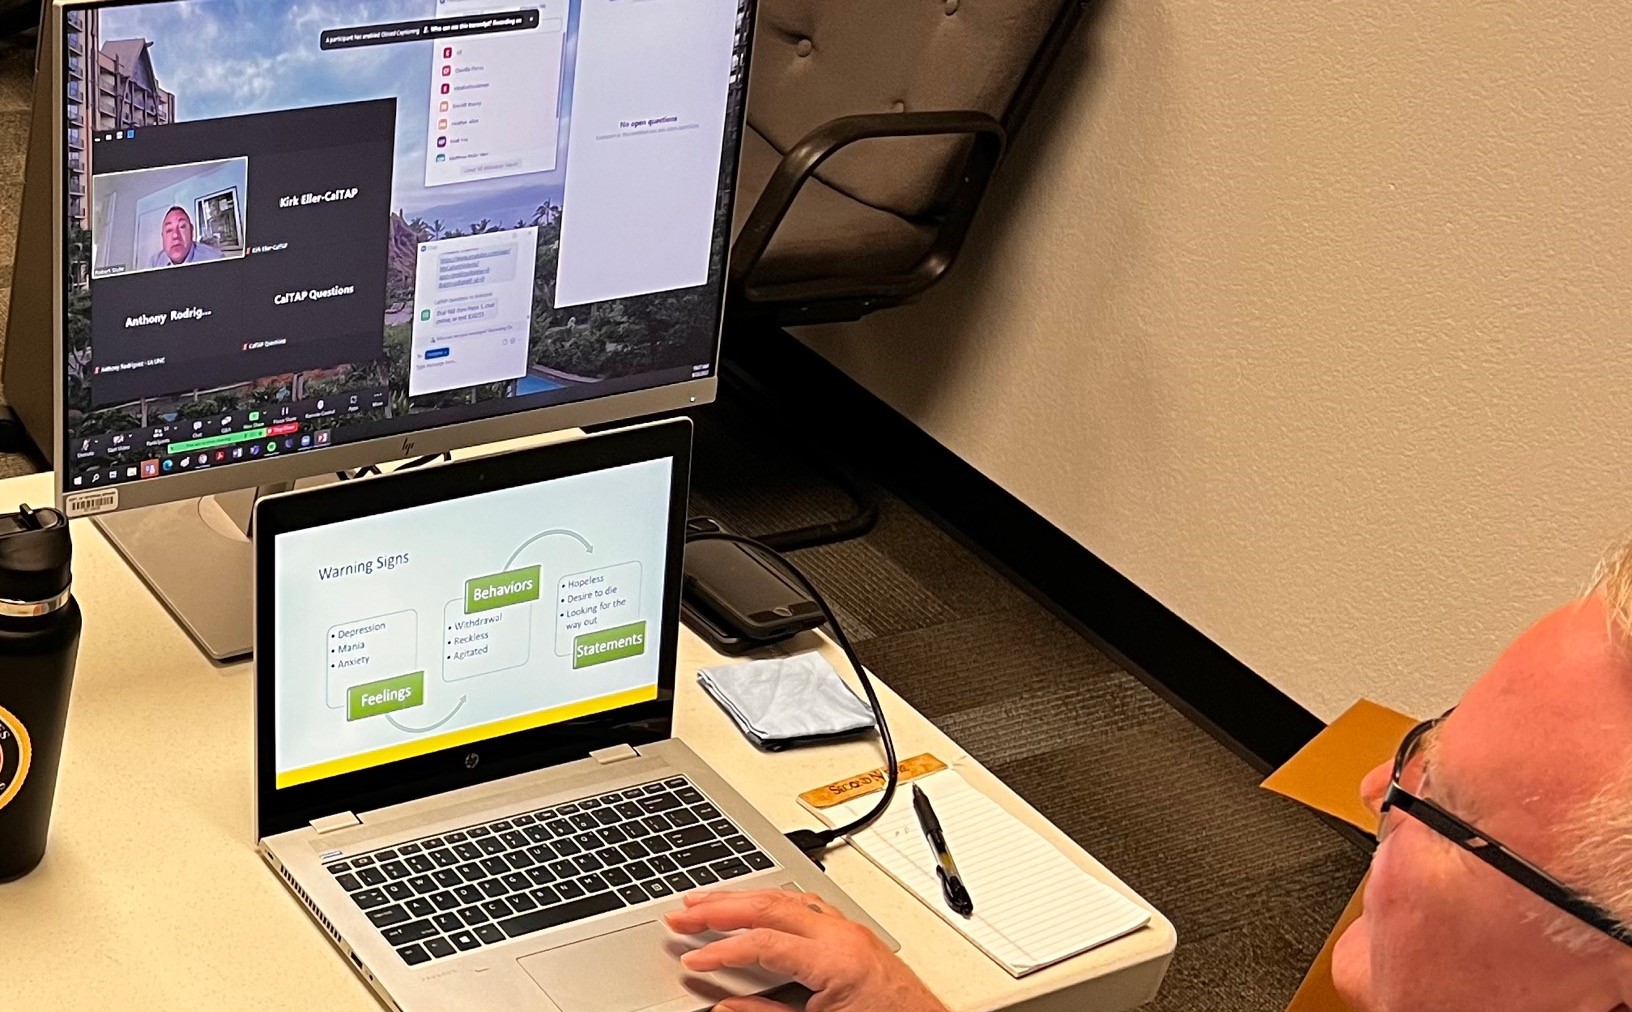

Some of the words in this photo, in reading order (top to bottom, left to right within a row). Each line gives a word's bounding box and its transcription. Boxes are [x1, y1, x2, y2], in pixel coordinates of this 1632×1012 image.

[630, 120, 647, 128] open
[648, 116, 678, 127] questions
[279, 197, 299, 208] Kirk
[301, 188, 359, 206] Eller-CalTAP
[274, 291, 307, 305] CalTAP
[308, 285, 354, 301] Questions
[125, 313, 167, 328] Anthony
[170, 307, 212, 321] Rodrig...
[319, 560, 373, 581] Warning
[376, 552, 409, 570] Signs
[473, 579, 533, 602] Behaviors
[568, 575, 604, 589] Hopeless
[567, 592, 593, 604] Desire
[604, 586, 618, 595] die
[567, 605, 598, 618] Looking
[599, 601, 611, 610] for
[612, 598, 627, 608] the
[454, 612, 503, 631] Withdrawal
[566, 621, 582, 631] way
[583, 617, 598, 627] out
[338, 622, 386, 640] Depression
[454, 631, 489, 646] Reckless
[338, 641, 365, 654] Mania
[453, 645, 489, 661] Agitated
[576, 633, 643, 658] Statements
[337, 656, 370, 669] Anxiety
[361, 685, 412, 708] Feelings
